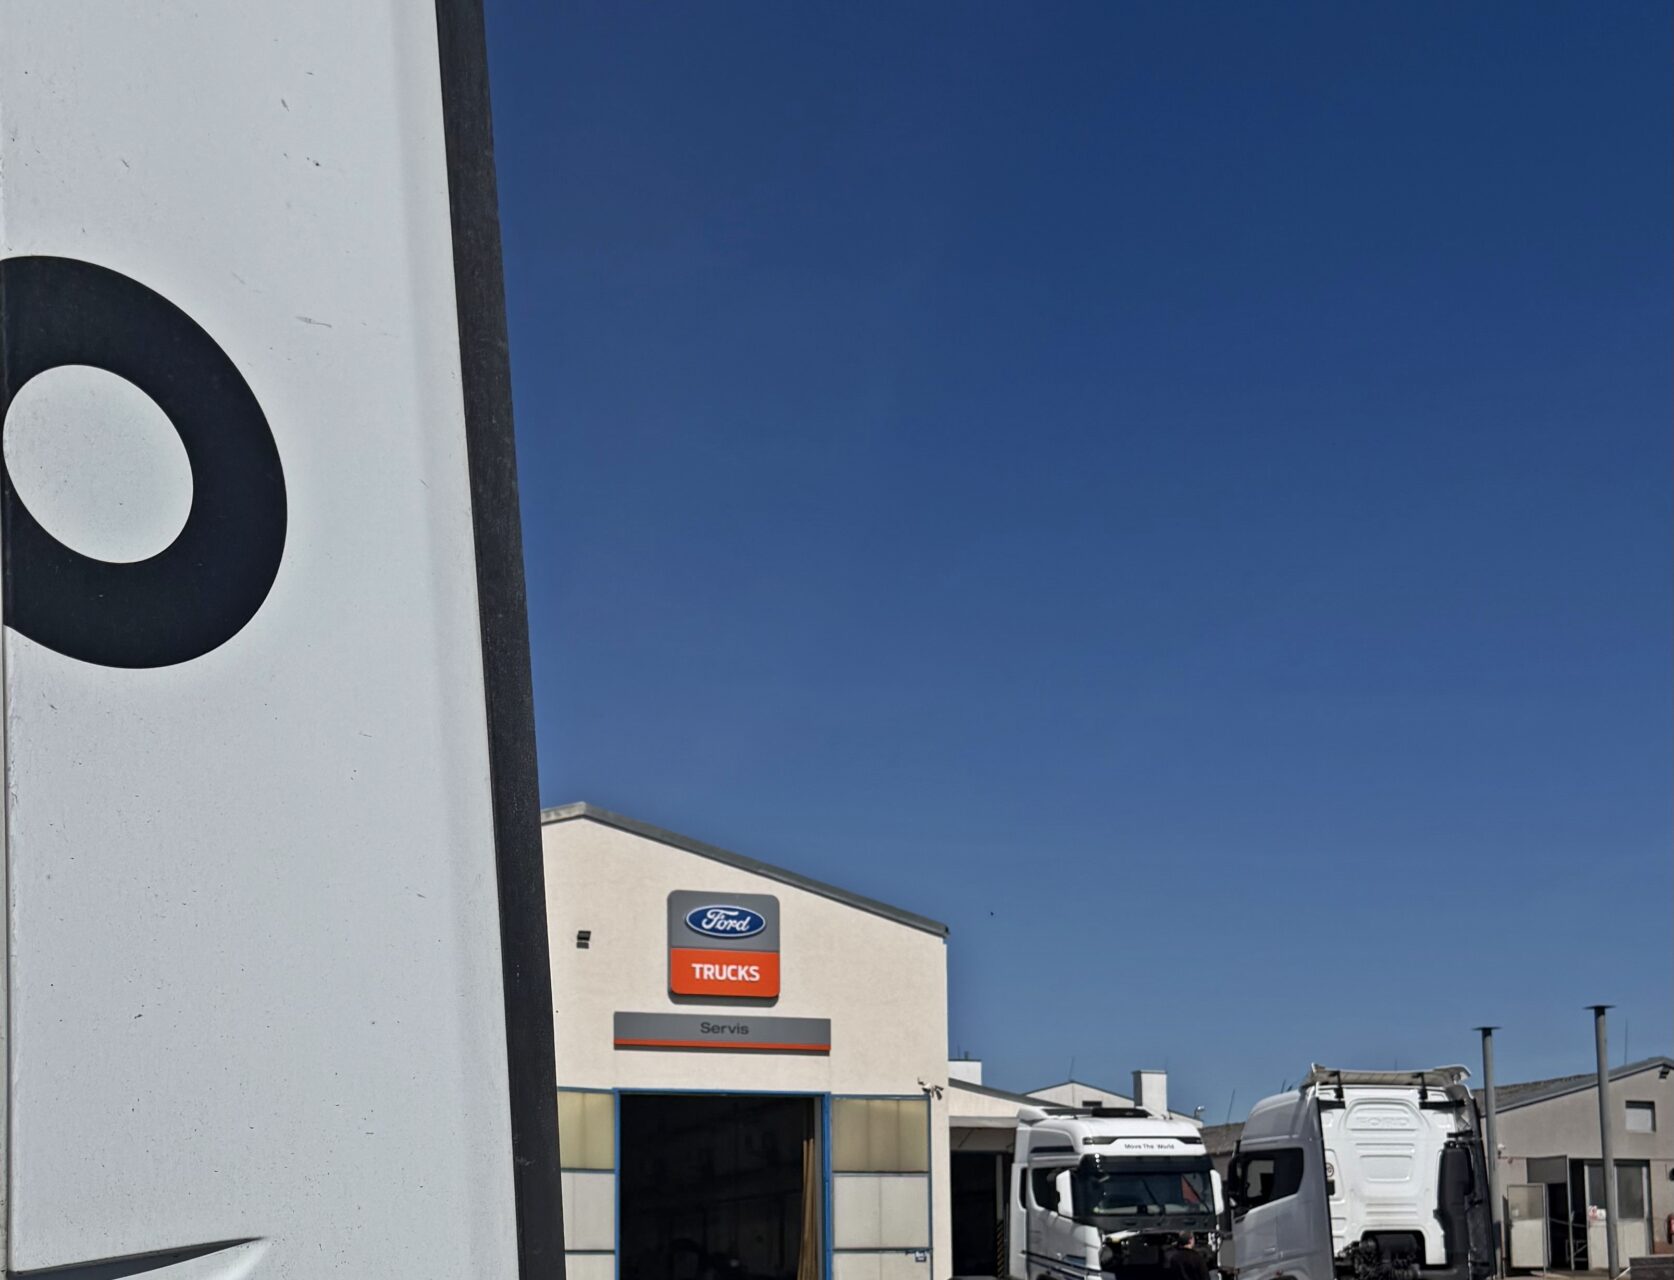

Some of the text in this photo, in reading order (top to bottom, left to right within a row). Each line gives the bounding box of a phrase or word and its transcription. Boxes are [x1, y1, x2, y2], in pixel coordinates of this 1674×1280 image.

[701, 909, 751, 932] Ford
[691, 963, 761, 982] TRUCKS
[700, 1022, 749, 1035] Servis
